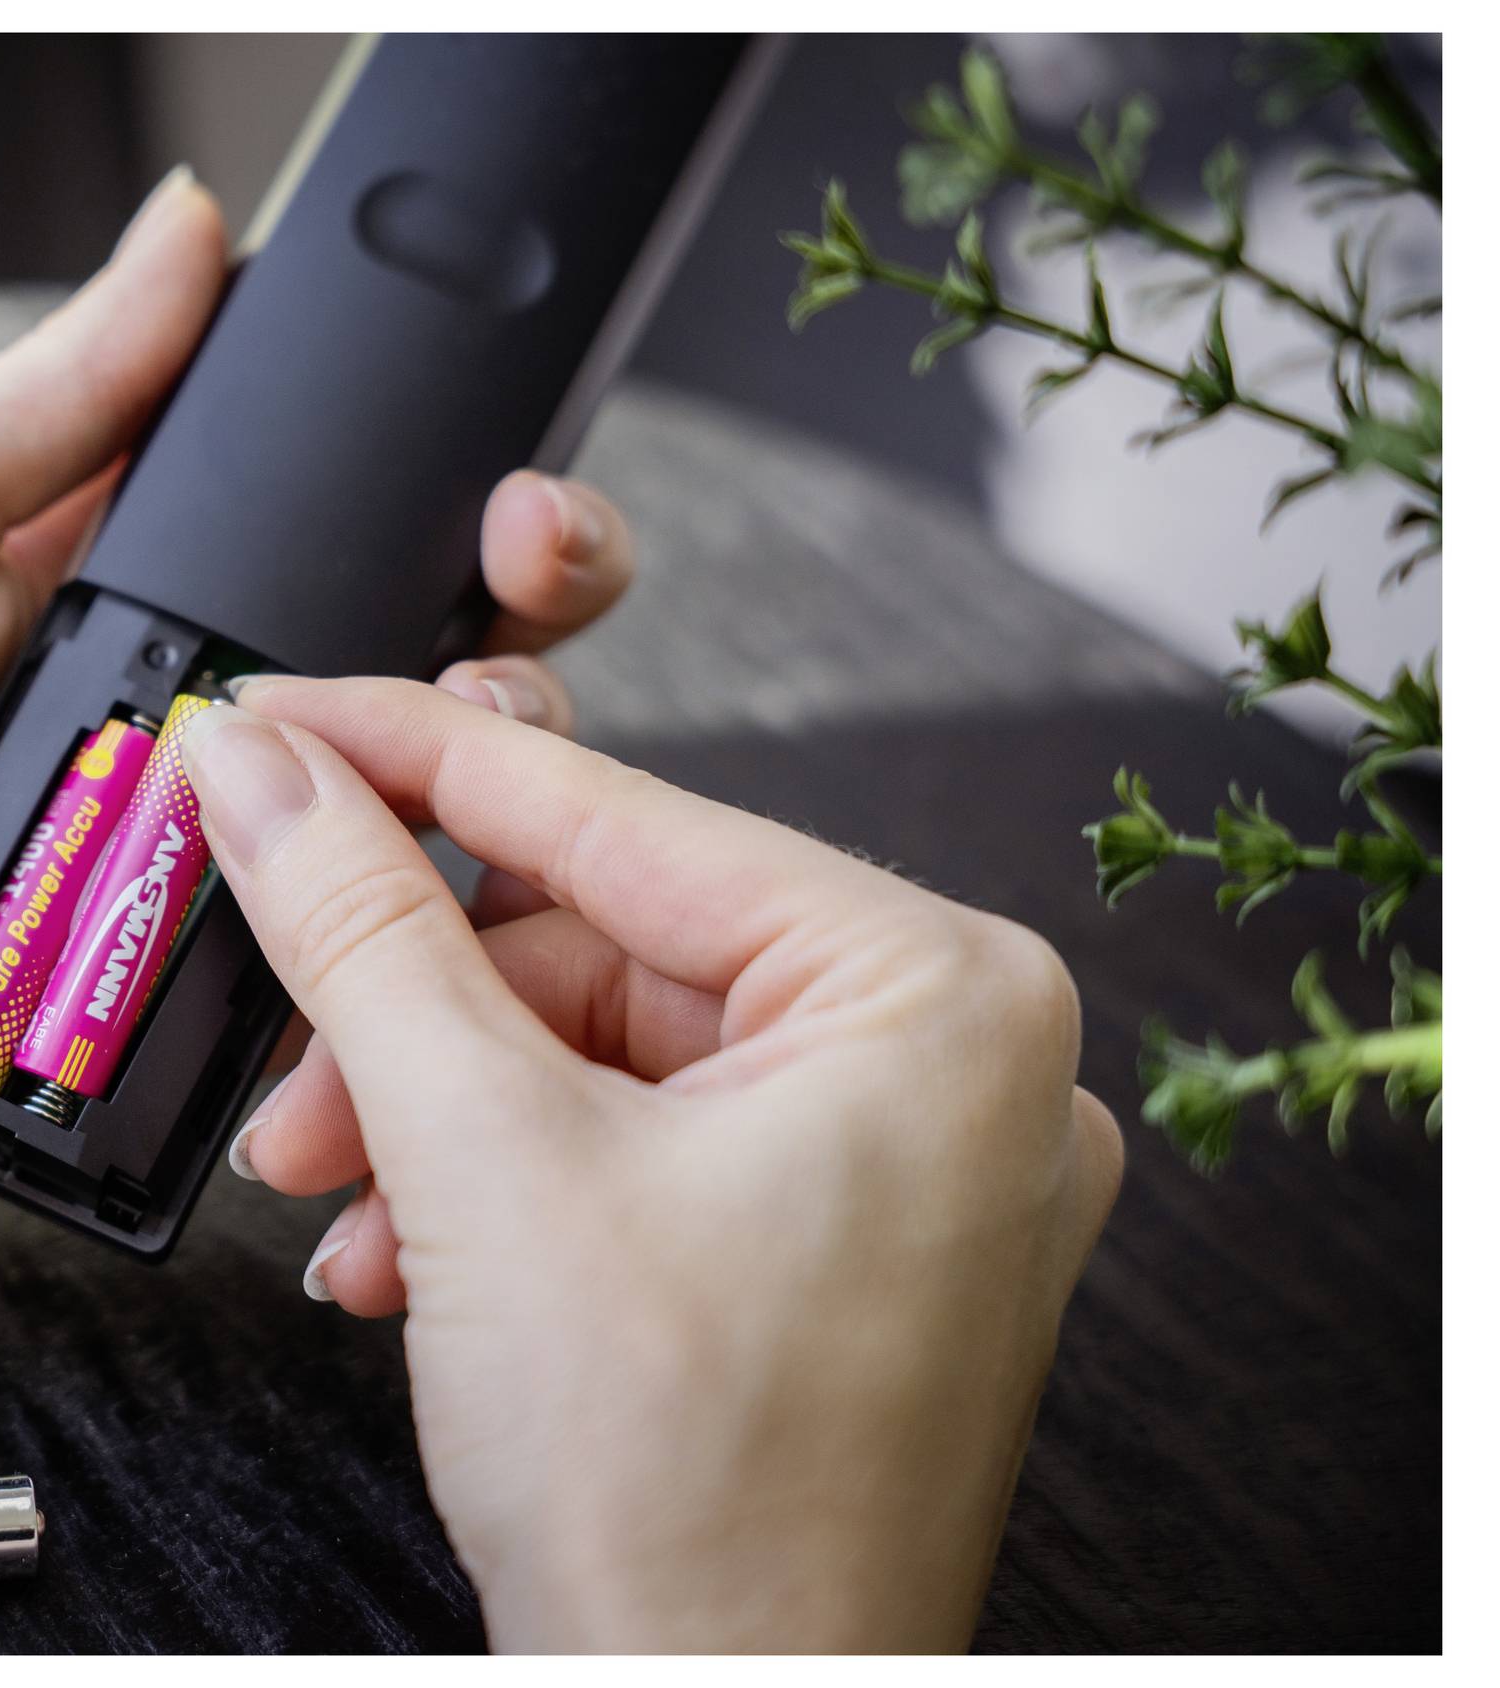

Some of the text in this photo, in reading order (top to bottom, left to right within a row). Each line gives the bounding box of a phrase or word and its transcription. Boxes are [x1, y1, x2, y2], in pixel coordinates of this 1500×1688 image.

[8, 863, 65, 944] Power
[53, 796, 102, 864] Accu
[85, 820, 185, 1021] ANSMANN
